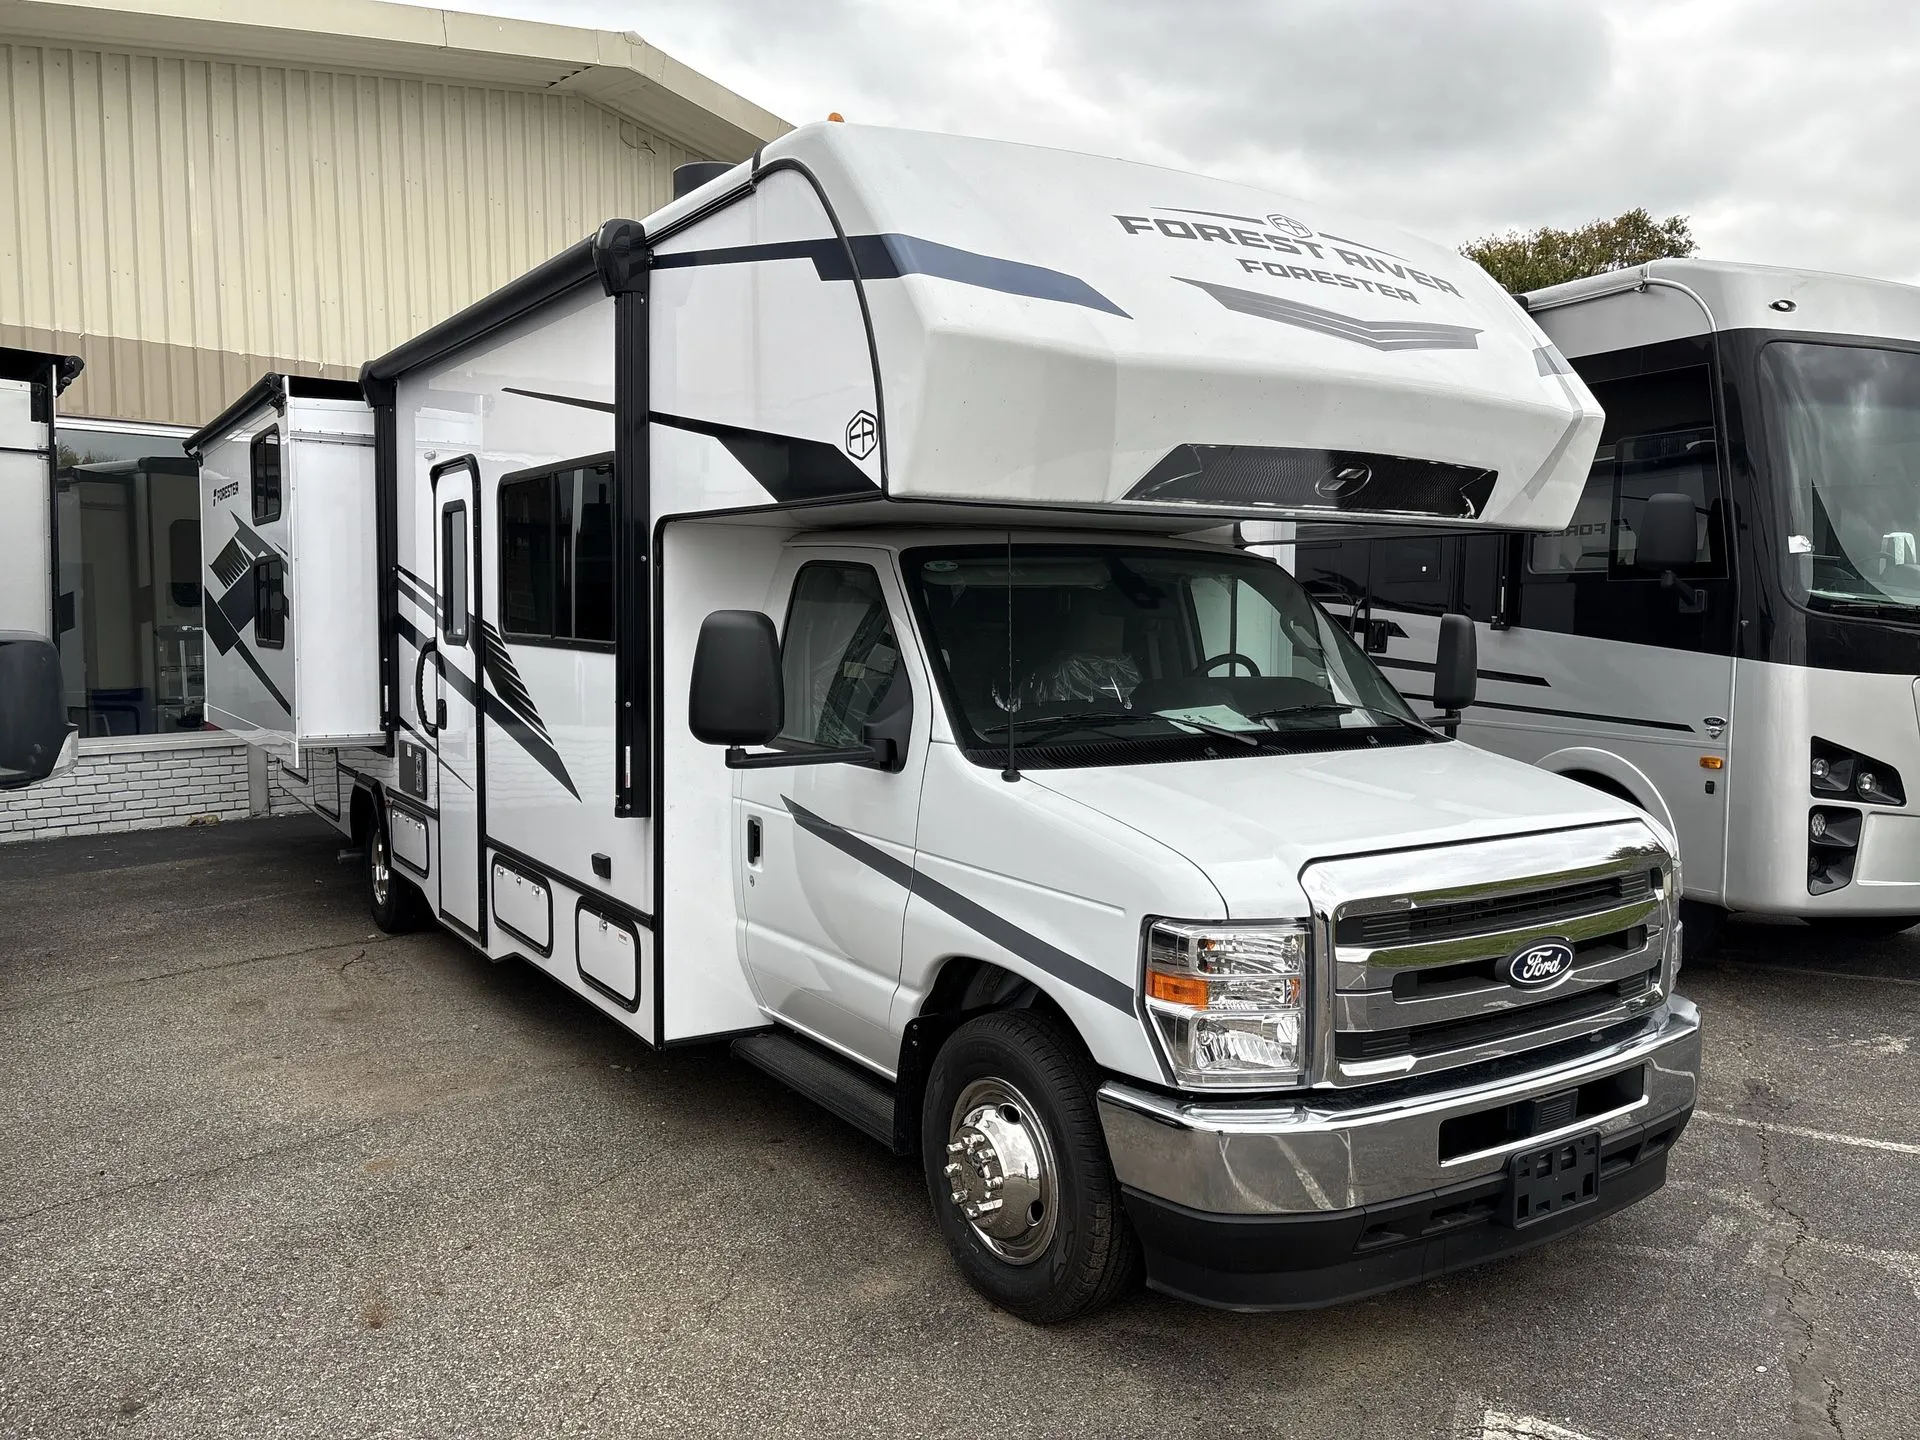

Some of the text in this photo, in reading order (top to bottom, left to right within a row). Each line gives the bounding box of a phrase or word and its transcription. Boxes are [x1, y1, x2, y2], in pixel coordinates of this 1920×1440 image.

[1111, 214, 1465, 300] FOREST RIVER
[1236, 257, 1422, 305] FORESTER
[217, 481, 238, 503] FORESTER
[1523, 949, 1562, 978] Ford
